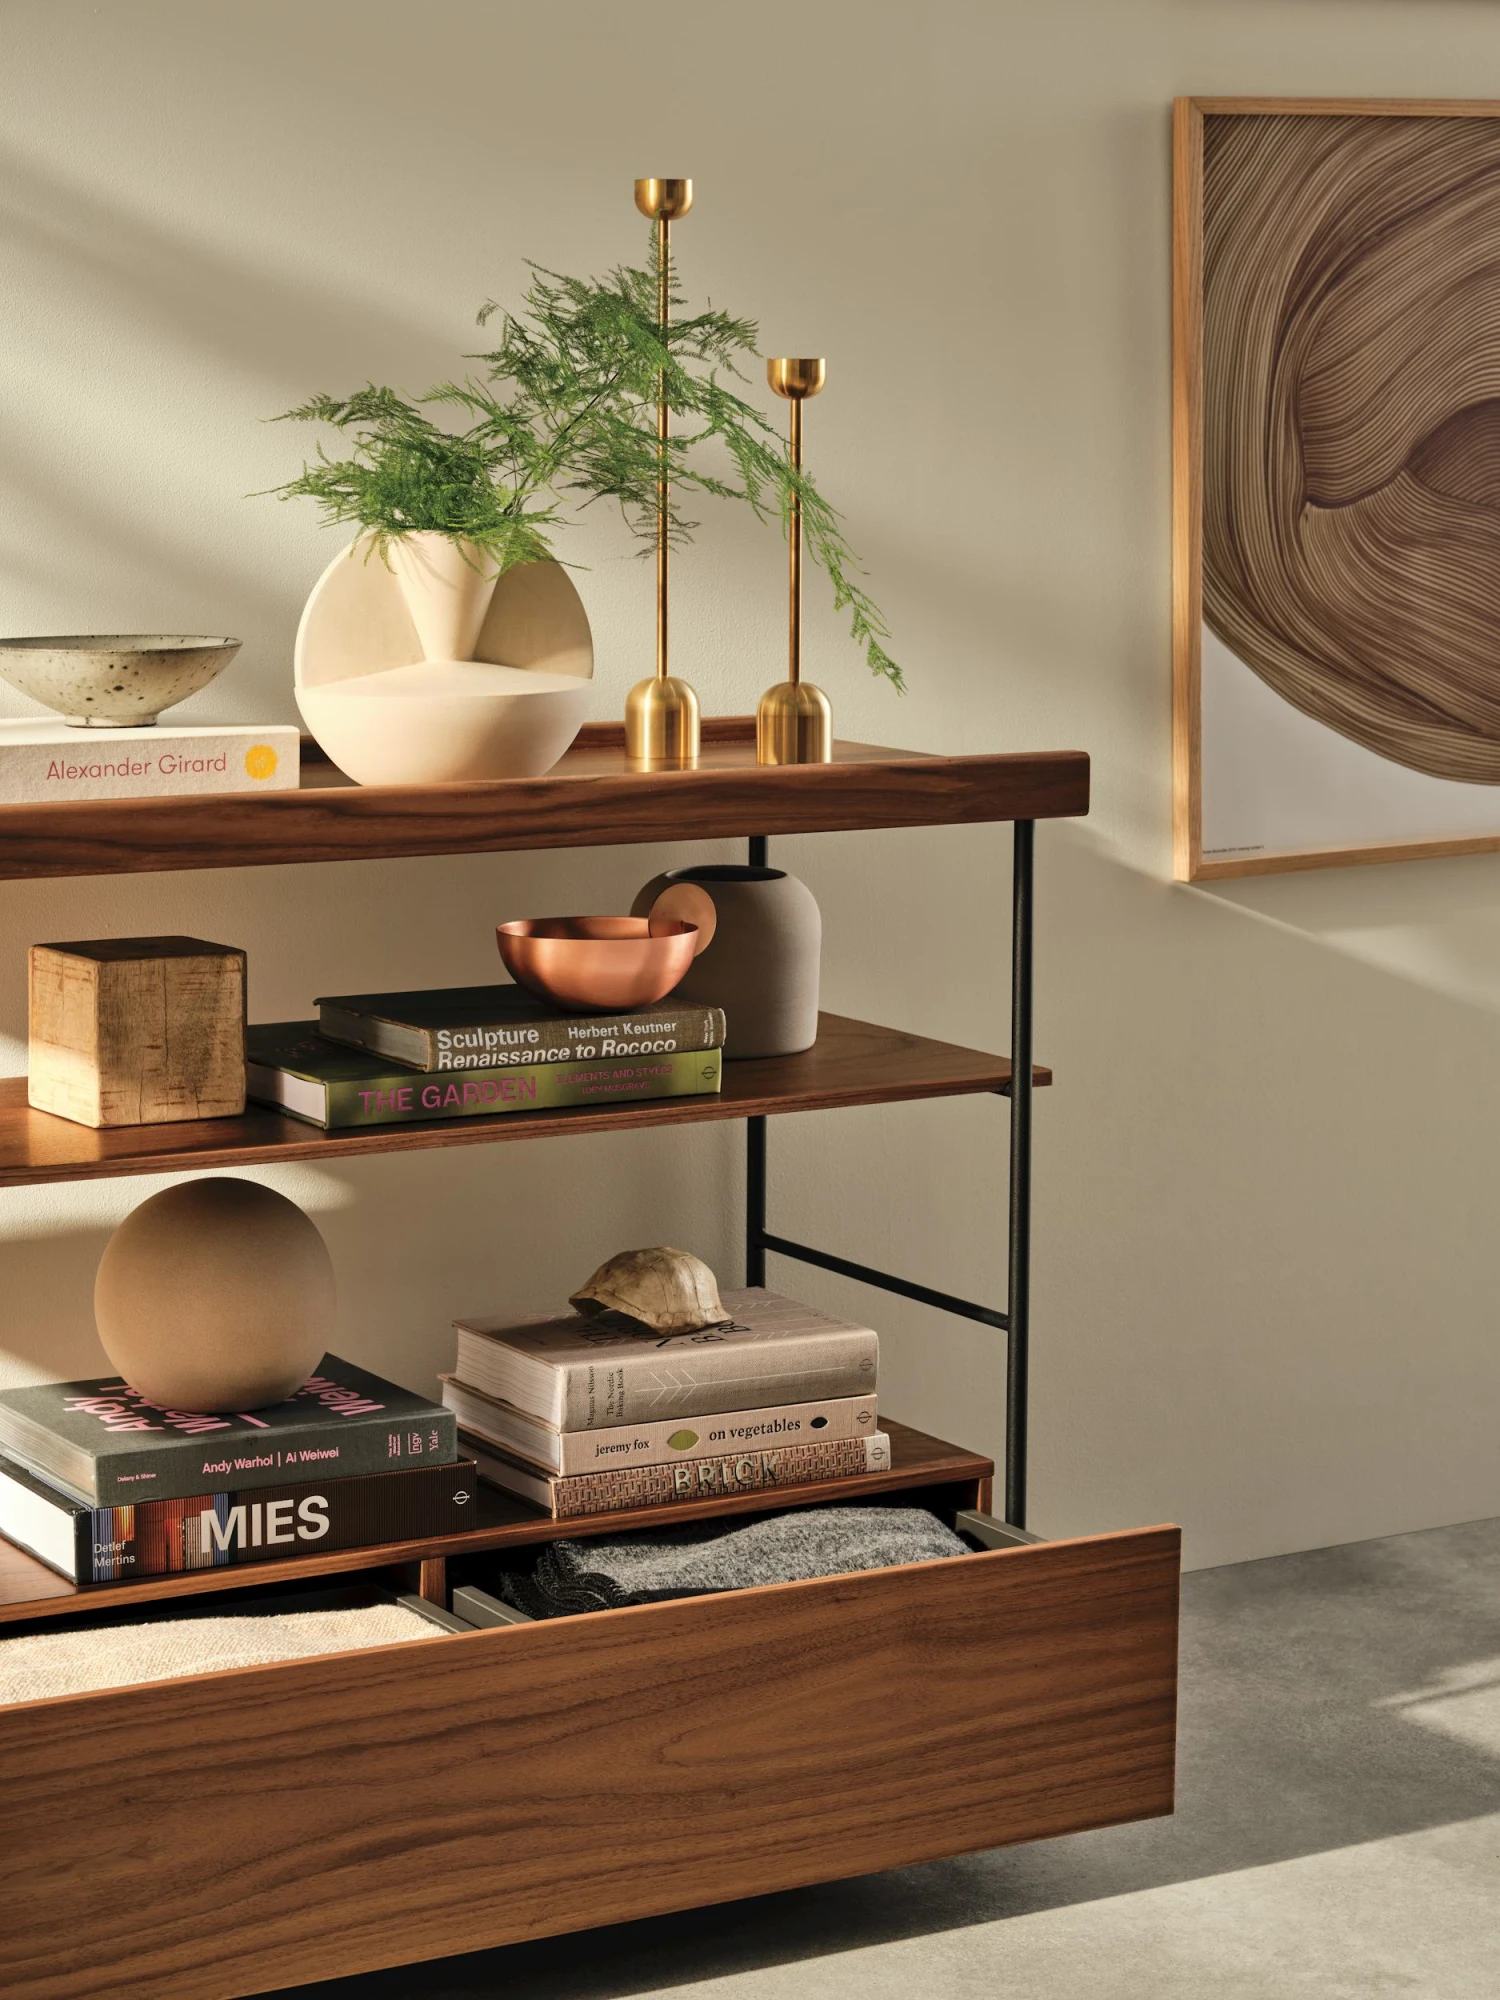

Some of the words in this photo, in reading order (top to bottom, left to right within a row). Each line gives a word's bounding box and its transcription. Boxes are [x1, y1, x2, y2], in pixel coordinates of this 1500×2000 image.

[46, 756, 152, 780] Alexander
[158, 752, 227, 775] Girard
[437, 1027, 540, 1051] Sculpture
[567, 1025, 619, 1040] Herbert
[622, 1022, 677, 1036] Keutner
[438, 1046, 571, 1070] Renaissance
[576, 1043, 596, 1059] to
[601, 1039, 677, 1057] Rococo
[555, 1070, 610, 1084] ELEMENTS
[612, 1068, 634, 1080] AND
[635, 1064, 674, 1077] STYLES
[604, 1081, 650, 1092] MUSGRAVE
[357, 1087, 414, 1114] THE
[421, 1075, 537, 1109] GARDEN
[606, 1372, 615, 1399] Nordic
[616, 1368, 624, 1389] Book
[587, 1395, 596, 1426] Magnus
[606, 1401, 615, 1416] The
[615, 1390, 625, 1418] Baking
[412, 1432, 422, 1451] ngv
[428, 1429, 439, 1452] Yale
[709, 1430, 726, 1442] on
[730, 1418, 801, 1440] vegetables
[202, 1461, 232, 1474] Andy
[234, 1454, 273, 1470] Warhol
[285, 1452, 297, 1464] Ai
[299, 1446, 339, 1462] Weiwei
[595, 1441, 632, 1458] jeremy
[633, 1439, 650, 1451] fox
[673, 1455, 780, 1495] BRICK
[200, 1495, 330, 1554] MIES
[94, 1540, 126, 1554] Detlef
[94, 1554, 136, 1568] Mertins
